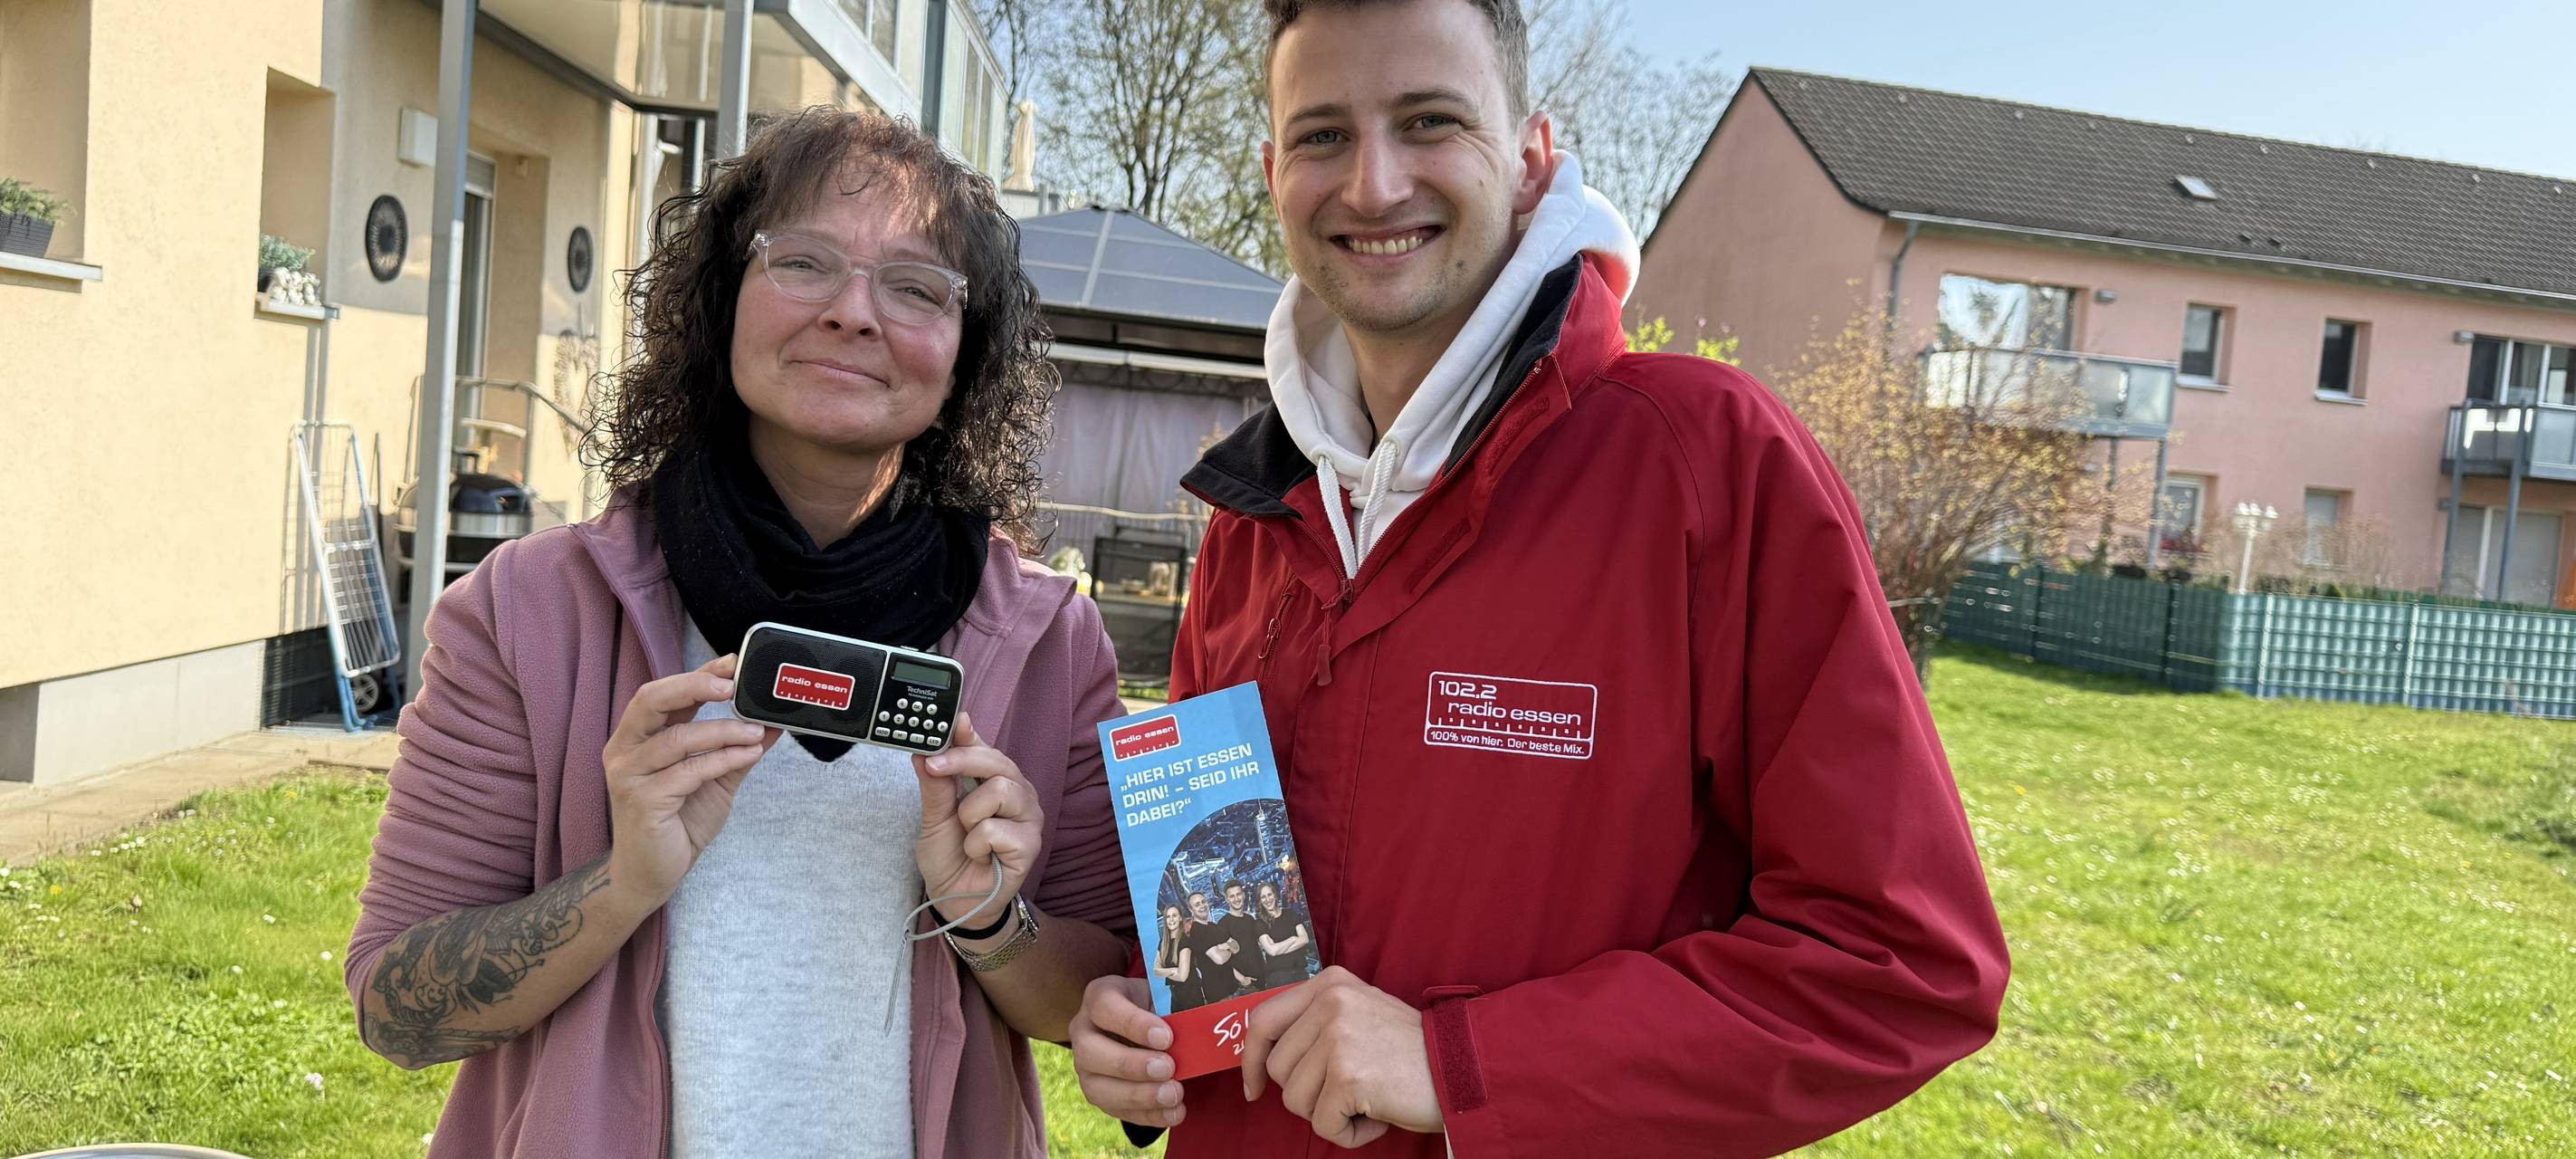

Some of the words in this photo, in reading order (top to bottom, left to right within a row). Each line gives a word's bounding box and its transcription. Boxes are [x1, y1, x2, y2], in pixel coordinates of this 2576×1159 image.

[781, 675, 812, 687] radio
[814, 682, 848, 694] essen
[906, 685, 939, 697] TechniSat
[1437, 680, 1497, 700] 102.2
[1447, 701, 1507, 719] radio
[1510, 709, 1581, 725] essen
[1115, 733, 1142, 746] radio
[1144, 725, 1175, 739] essen
[1430, 730, 1459, 742] 100%
[1461, 734, 1480, 744] von
[1481, 735, 1503, 747] hier.
[1507, 738, 1528, 749] Der
[1529, 741, 1561, 752] beste
[1562, 743, 1585, 754] Mix.
[1120, 767, 1165, 792] „HIER
[1169, 758, 1194, 777] IST
[1197, 742, 1253, 769] ESSEN
[1122, 785, 1169, 809] DRIN!
[1188, 771, 1226, 791] SEID
[1230, 761, 1261, 781] IHR
